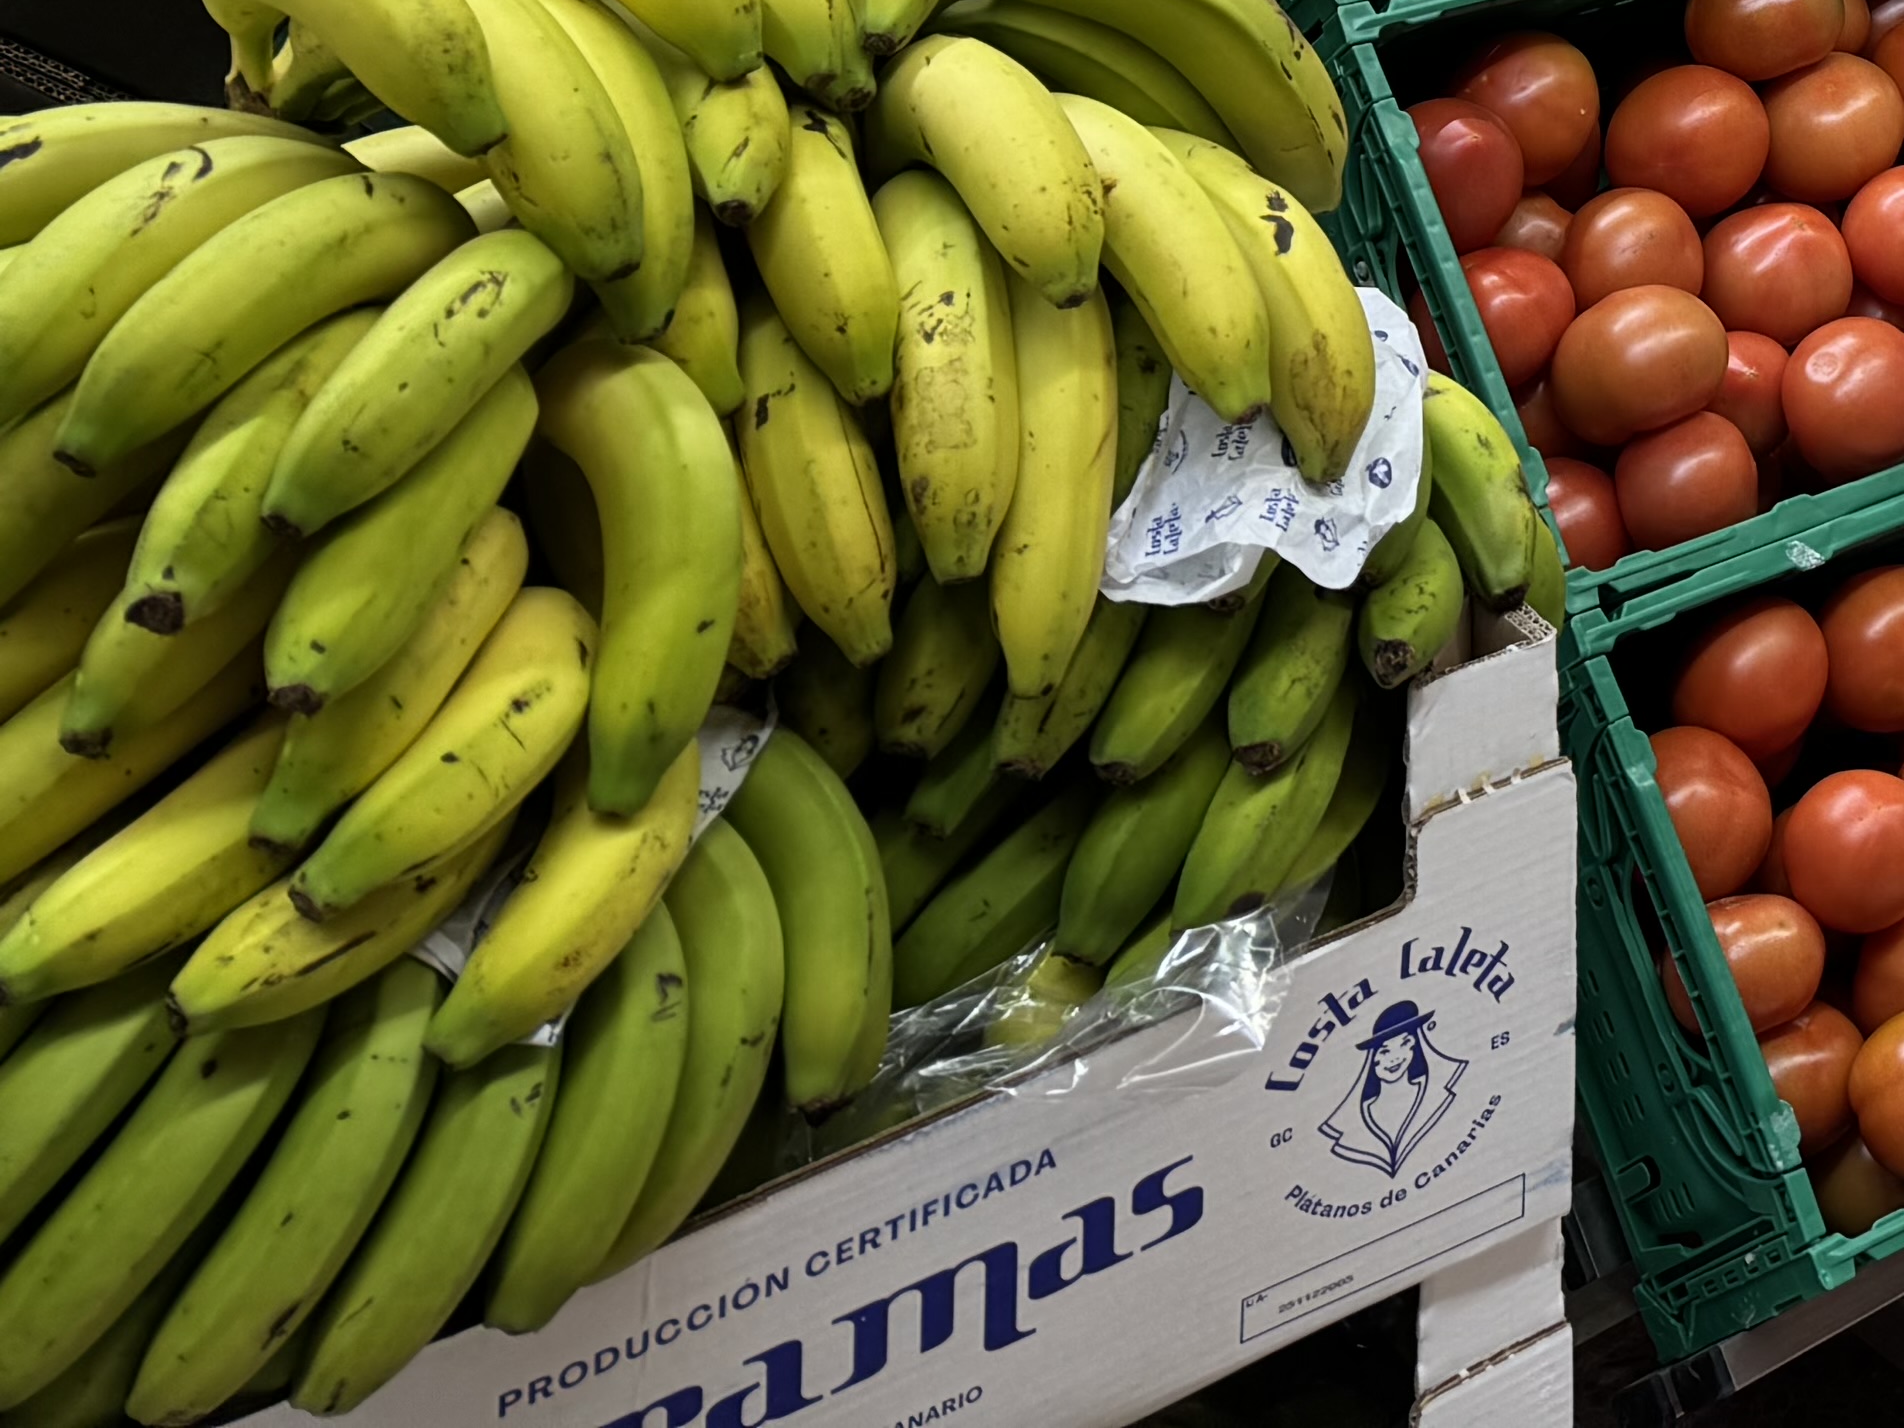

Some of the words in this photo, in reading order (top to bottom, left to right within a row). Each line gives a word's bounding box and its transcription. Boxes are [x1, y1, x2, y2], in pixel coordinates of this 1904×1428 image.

[1265, 977, 1378, 1092] Costa
[1400, 926, 1515, 1004] Caleta
[1491, 1031, 1510, 1050] ES
[1270, 1127, 1293, 1148] GC
[1285, 1184, 1372, 1219] Plátanos
[1380, 1186, 1408, 1208] de
[1413, 1093, 1502, 1189] Canarias
[498, 1272, 789, 1418] PRODUCCIÓN
[805, 1148, 1057, 1278] CERTIFICADA
